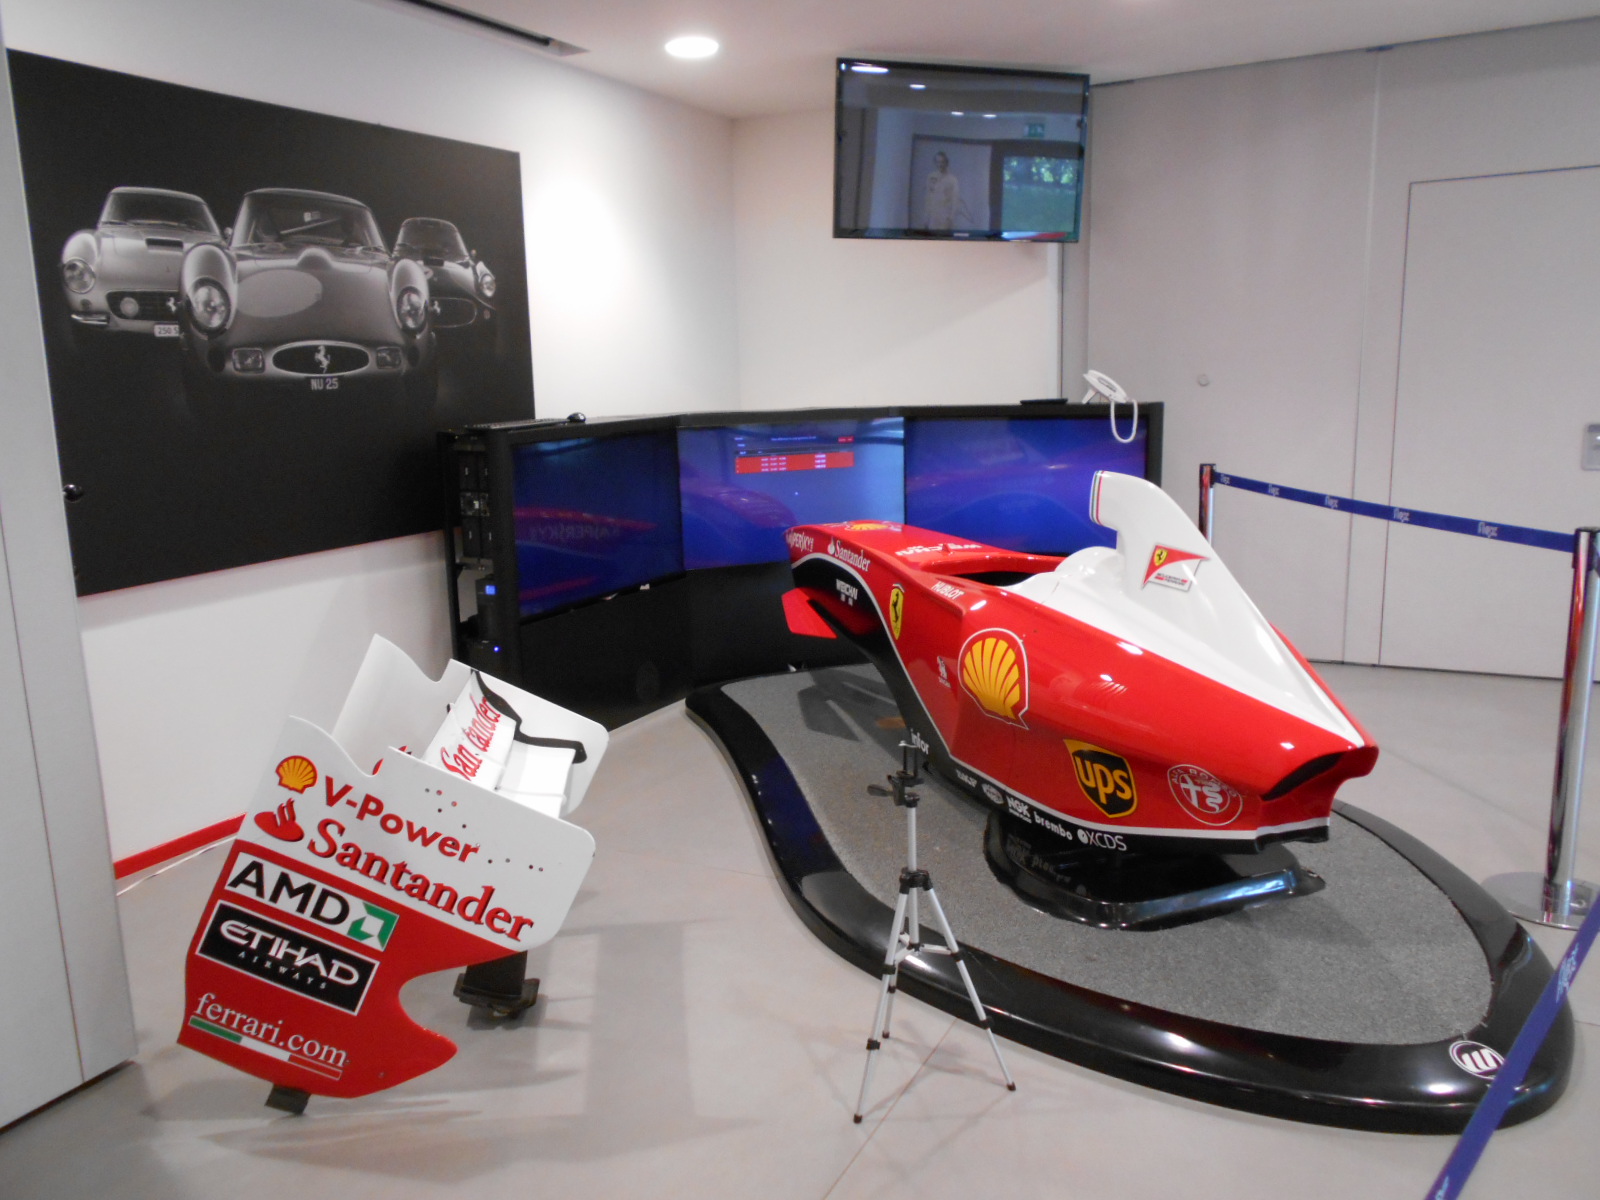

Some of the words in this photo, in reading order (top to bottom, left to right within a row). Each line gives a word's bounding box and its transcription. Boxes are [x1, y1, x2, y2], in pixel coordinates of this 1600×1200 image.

[158, 326, 173, 335] 250
[310, 378, 324, 391] NU
[325, 377, 339, 390] 25
[834, 539, 871, 573] Santander
[931, 580, 966, 600] HUBLOT
[910, 728, 930, 756] infor
[325, 774, 480, 864] V-Power
[1006, 795, 1031, 818] NGK
[1033, 810, 1074, 842] brembo
[227, 859, 351, 927] AMD
[307, 817, 535, 943] Santander
[220, 918, 360, 988] ETIHAD
[238, 950, 328, 990] AIRWAYS
[196, 992, 349, 1067] ferrari.com
